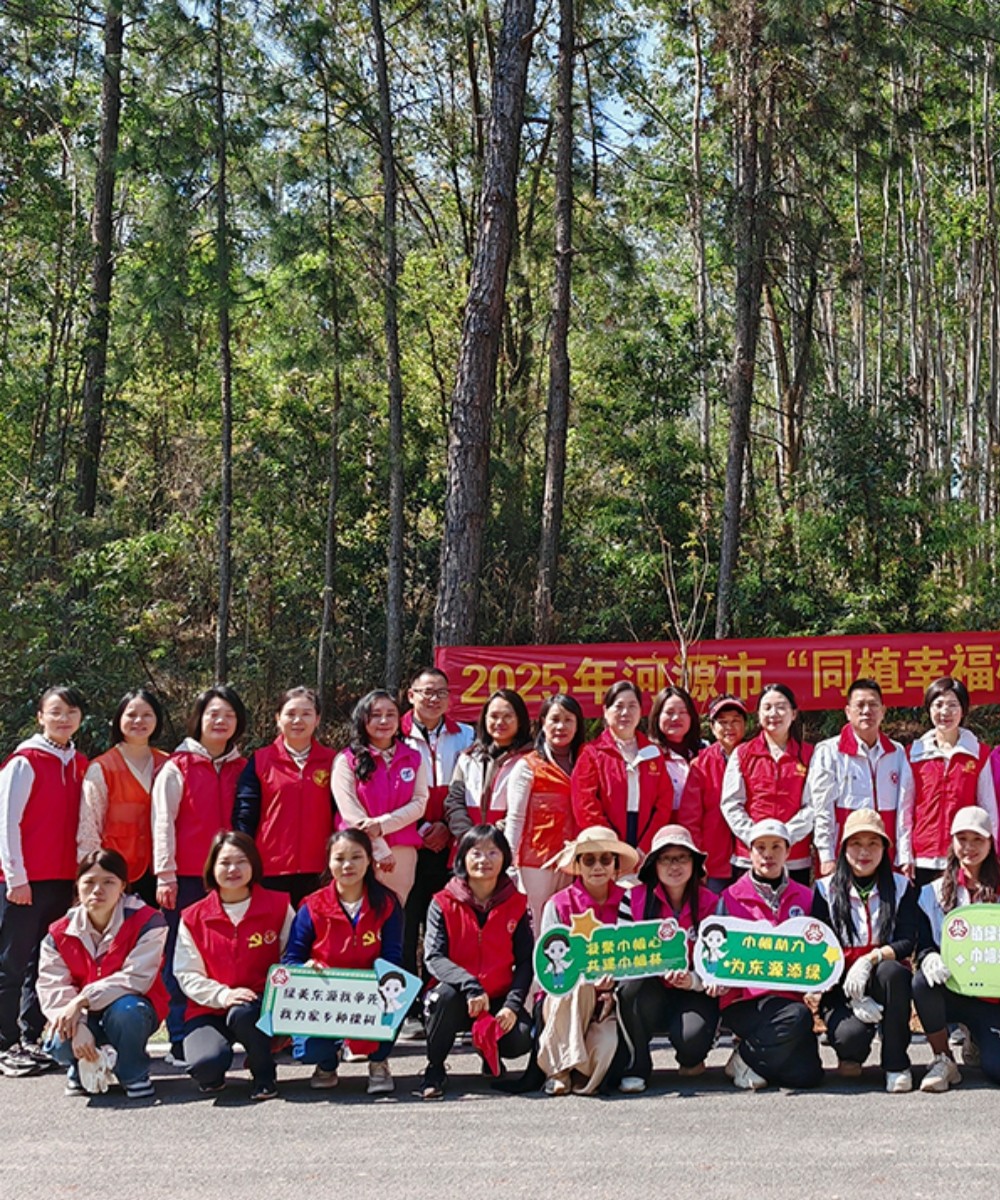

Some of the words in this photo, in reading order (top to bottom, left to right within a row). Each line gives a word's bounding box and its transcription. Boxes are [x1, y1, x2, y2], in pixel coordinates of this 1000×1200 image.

[586, 937, 662, 956] 凝聚巾帼心
[742, 935, 805, 953] 巾帼助力
[586, 952, 663, 972] 共建巾帼林
[730, 958, 821, 980] 为东源添绿
[283, 987, 379, 1005] 绿美东源我争先
[279, 1007, 376, 1025] 我为家乡种棵树
